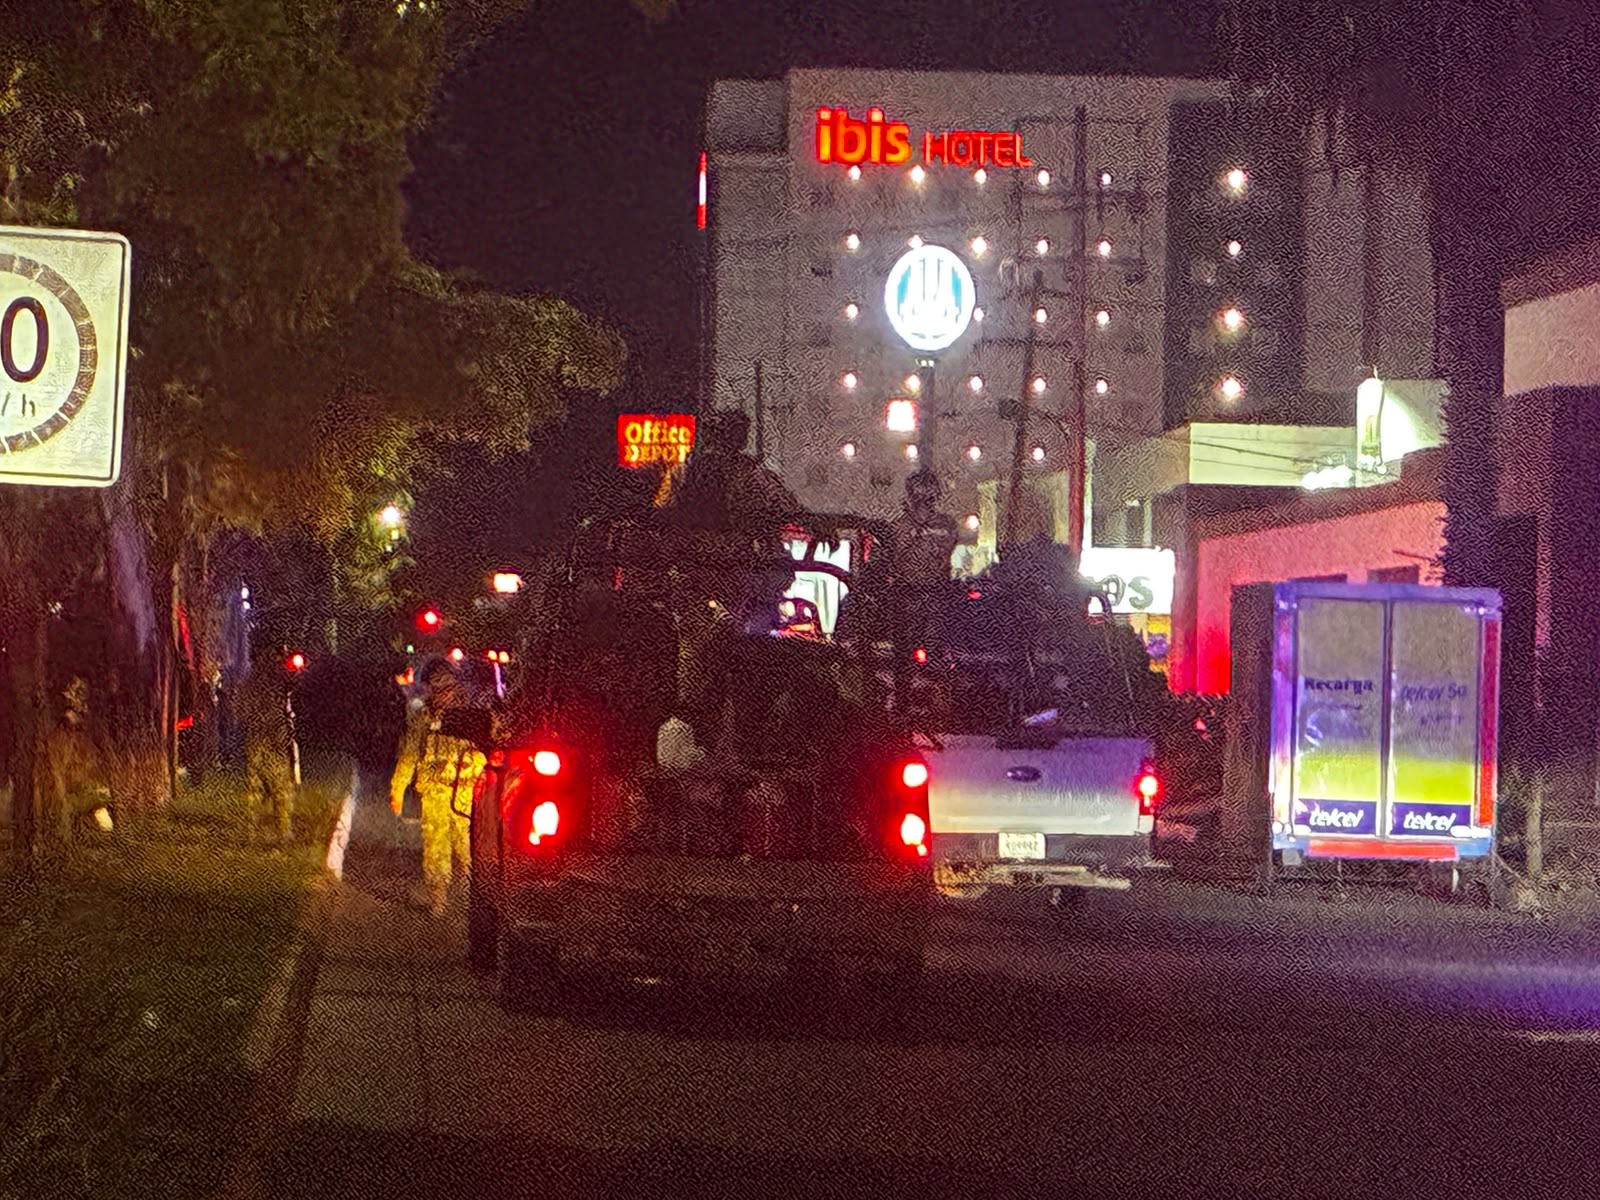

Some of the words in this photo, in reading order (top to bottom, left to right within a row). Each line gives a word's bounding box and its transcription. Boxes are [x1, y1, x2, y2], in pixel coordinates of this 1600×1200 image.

[816, 106, 911, 164] ibis
[923, 131, 1032, 167] HOTEL
[1308, 804, 1364, 828] telcel
[1403, 810, 1457, 831] telcel
